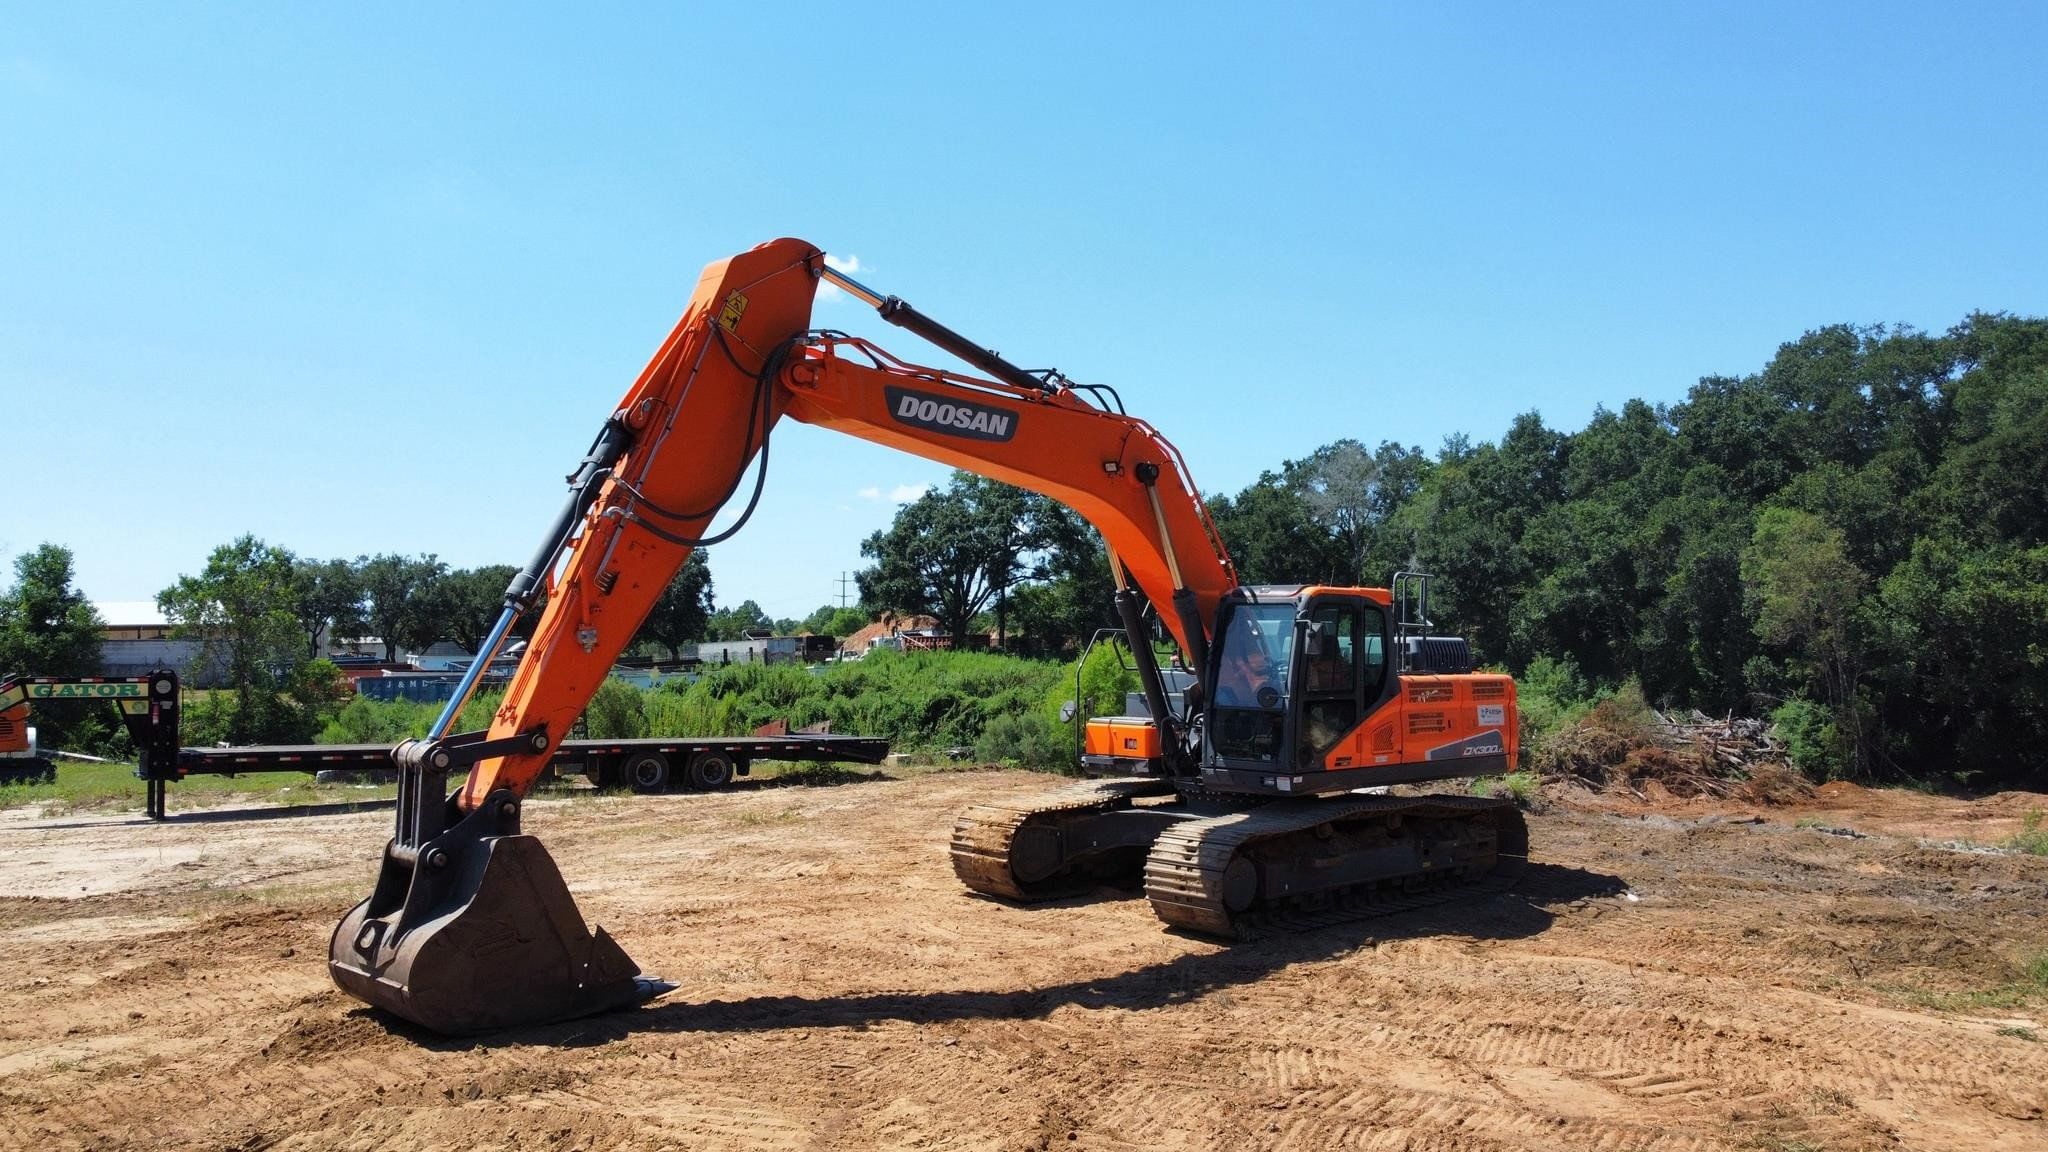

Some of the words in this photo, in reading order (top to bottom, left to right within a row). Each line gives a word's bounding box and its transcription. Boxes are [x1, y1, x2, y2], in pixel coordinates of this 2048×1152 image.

[897, 395, 1009, 436] DOOSAN
[33, 684, 141, 697] GATOR
[398, 680, 405, 689] &
[409, 680, 417, 688] M
